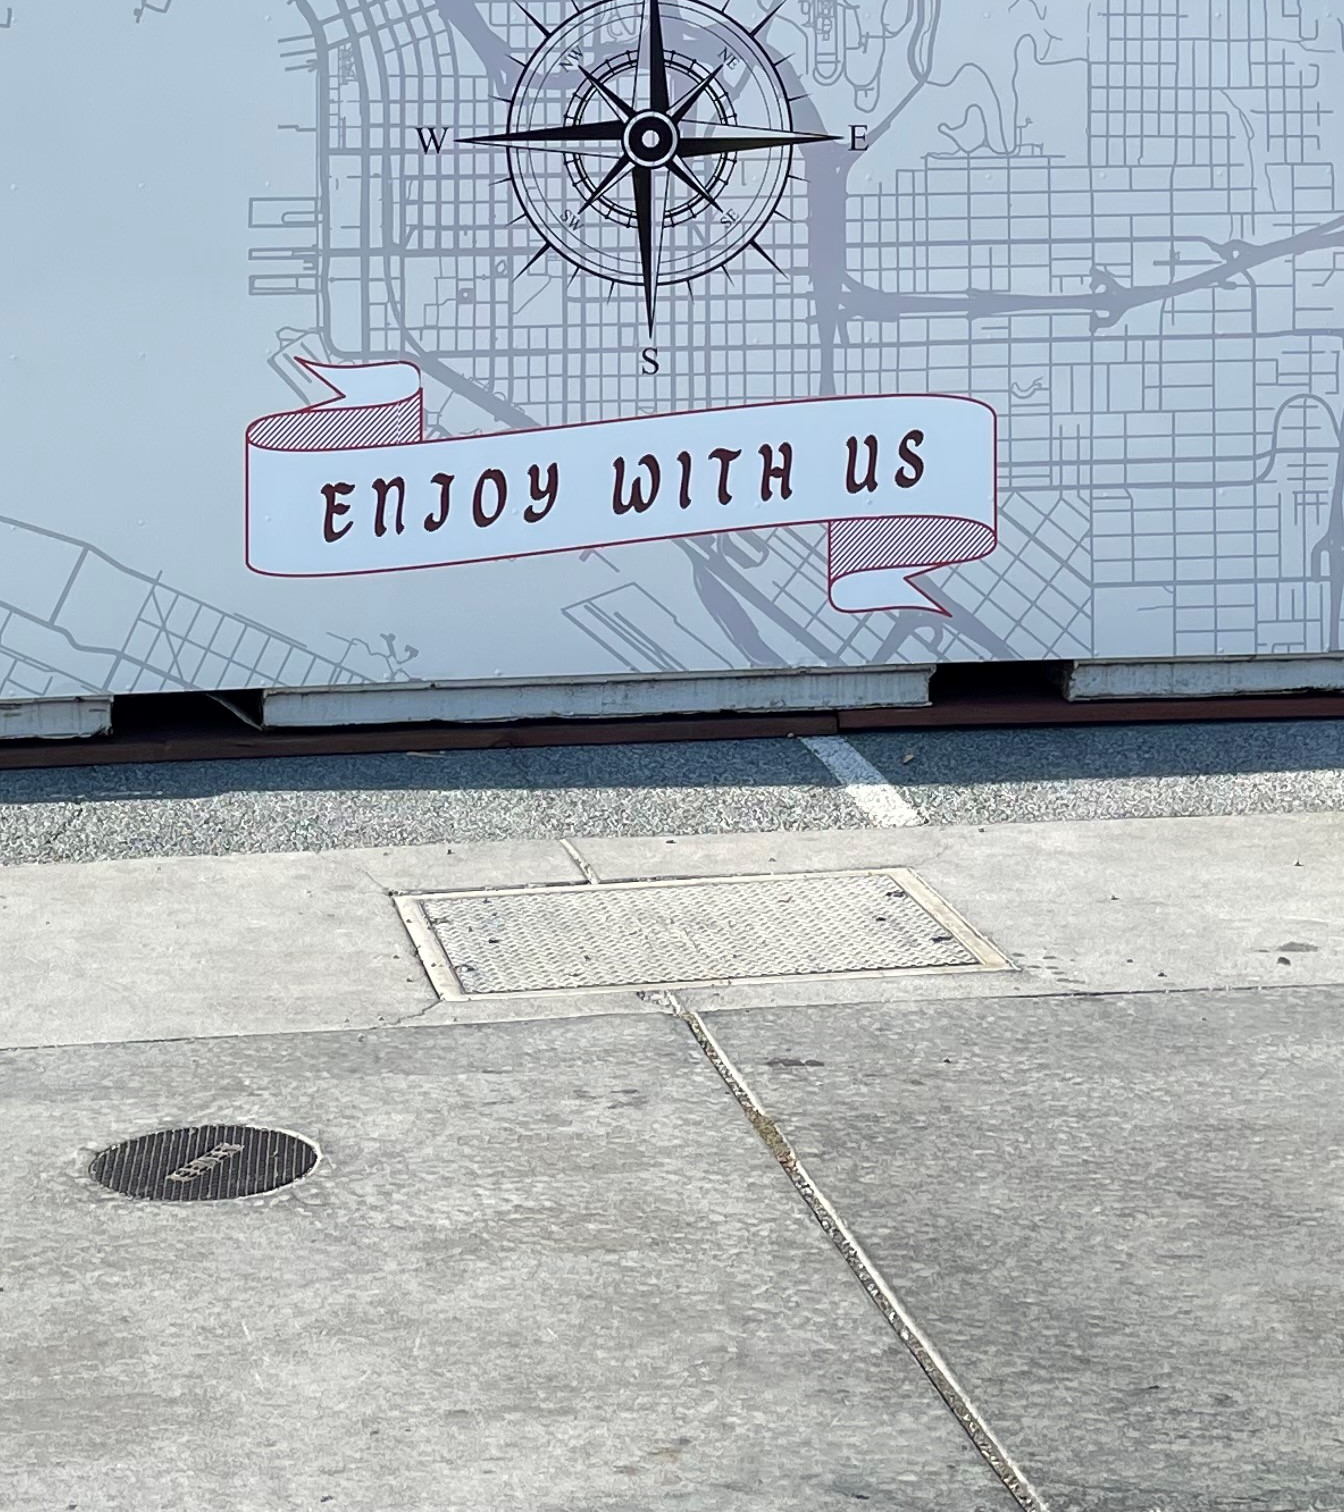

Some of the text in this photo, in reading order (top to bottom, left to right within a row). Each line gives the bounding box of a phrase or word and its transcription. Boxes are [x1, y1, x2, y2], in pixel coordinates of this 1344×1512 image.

[559, 45, 584, 72] NW
[717, 46, 741, 71] NE
[416, 127, 453, 154] W
[848, 124, 869, 152] E
[560, 209, 585, 233] SW
[720, 208, 741, 229] SE
[642, 347, 660, 375] S
[320, 429, 926, 544] ENJOY WITH US
